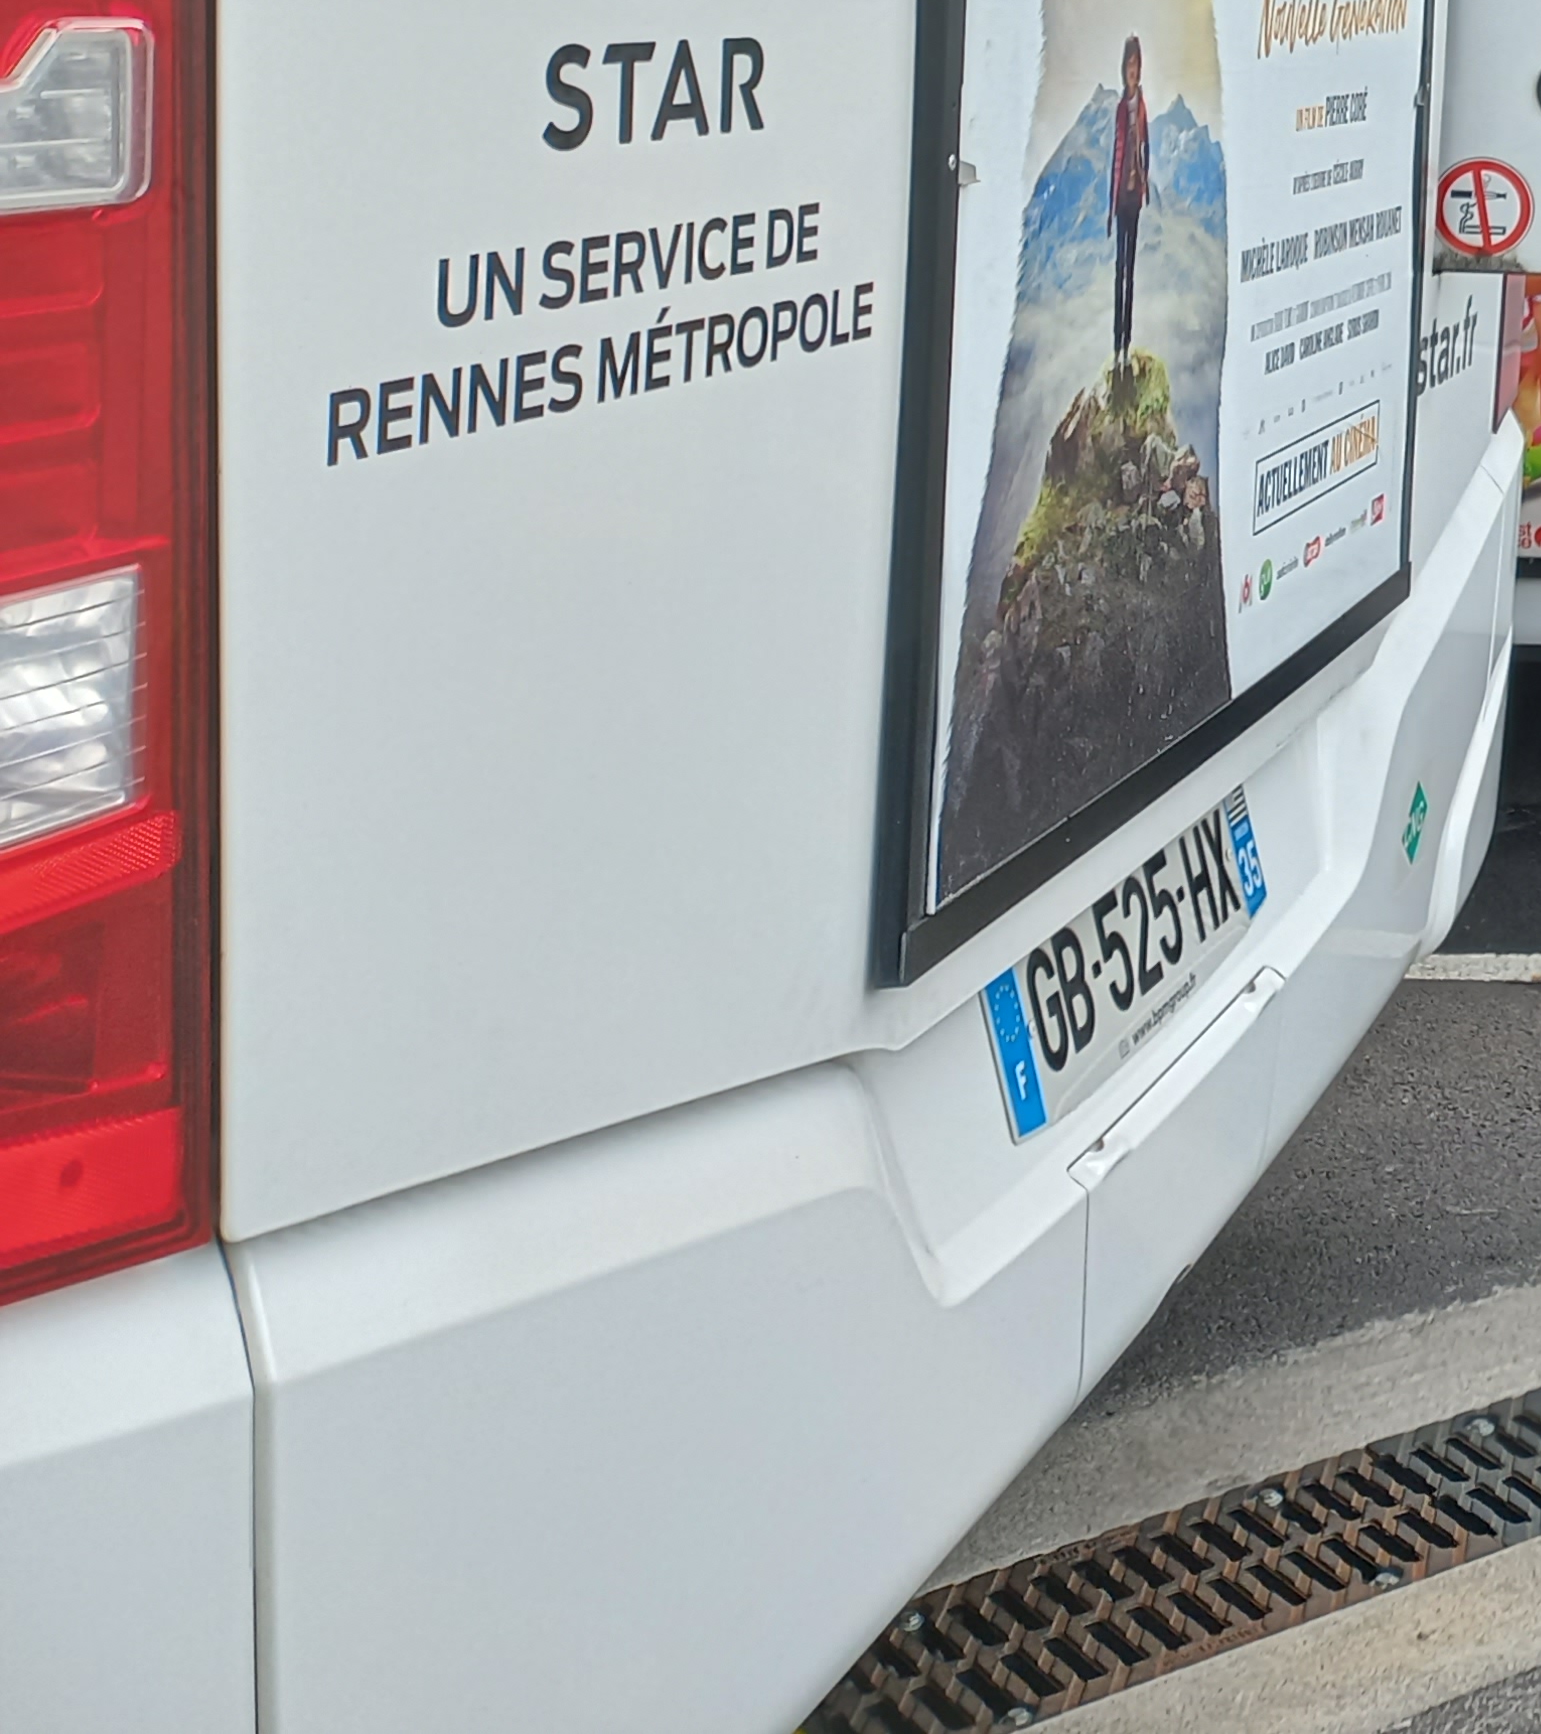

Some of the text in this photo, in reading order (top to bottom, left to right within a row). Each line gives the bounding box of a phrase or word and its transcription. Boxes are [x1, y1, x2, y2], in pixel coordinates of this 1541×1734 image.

[542, 36, 767, 152] STAR
[437, 202, 821, 329] UN SERVICE DE
[327, 280, 876, 467] RENNES MÉTROPOLE
[1256, 438, 1330, 518] ACTUELLEMENT
[1329, 431, 1343, 475] AU
[1014, 1060, 1028, 1101] F
[1238, 839, 1262, 897] 35
